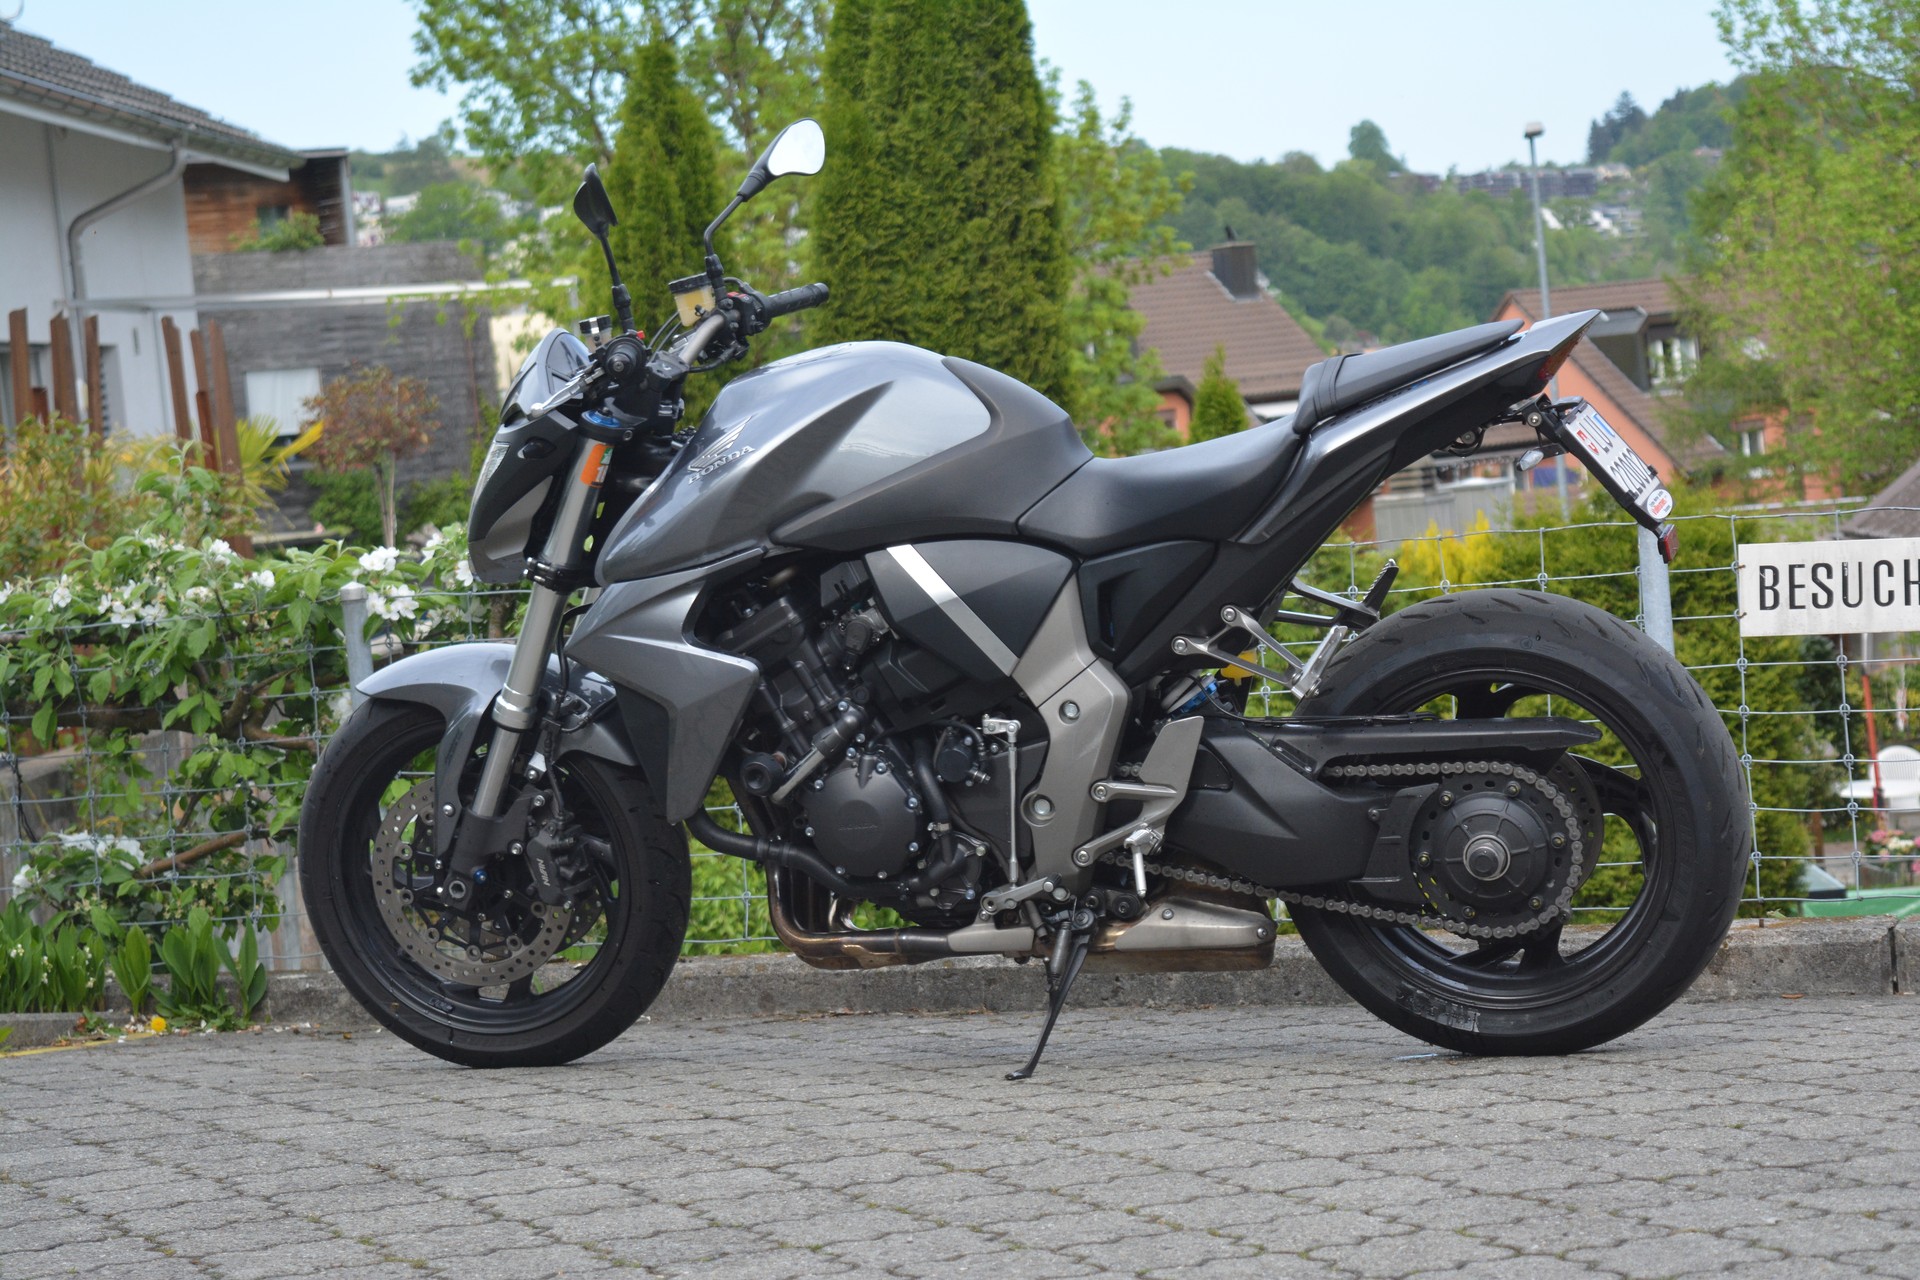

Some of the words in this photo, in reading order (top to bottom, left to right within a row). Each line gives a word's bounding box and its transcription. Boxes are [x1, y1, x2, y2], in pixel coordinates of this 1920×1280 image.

[1579, 415, 1613, 452] LU
[688, 445, 756, 485] HONDA
[1610, 447, 1654, 500] 22002
[1759, 559, 1920, 611] BESUCH
